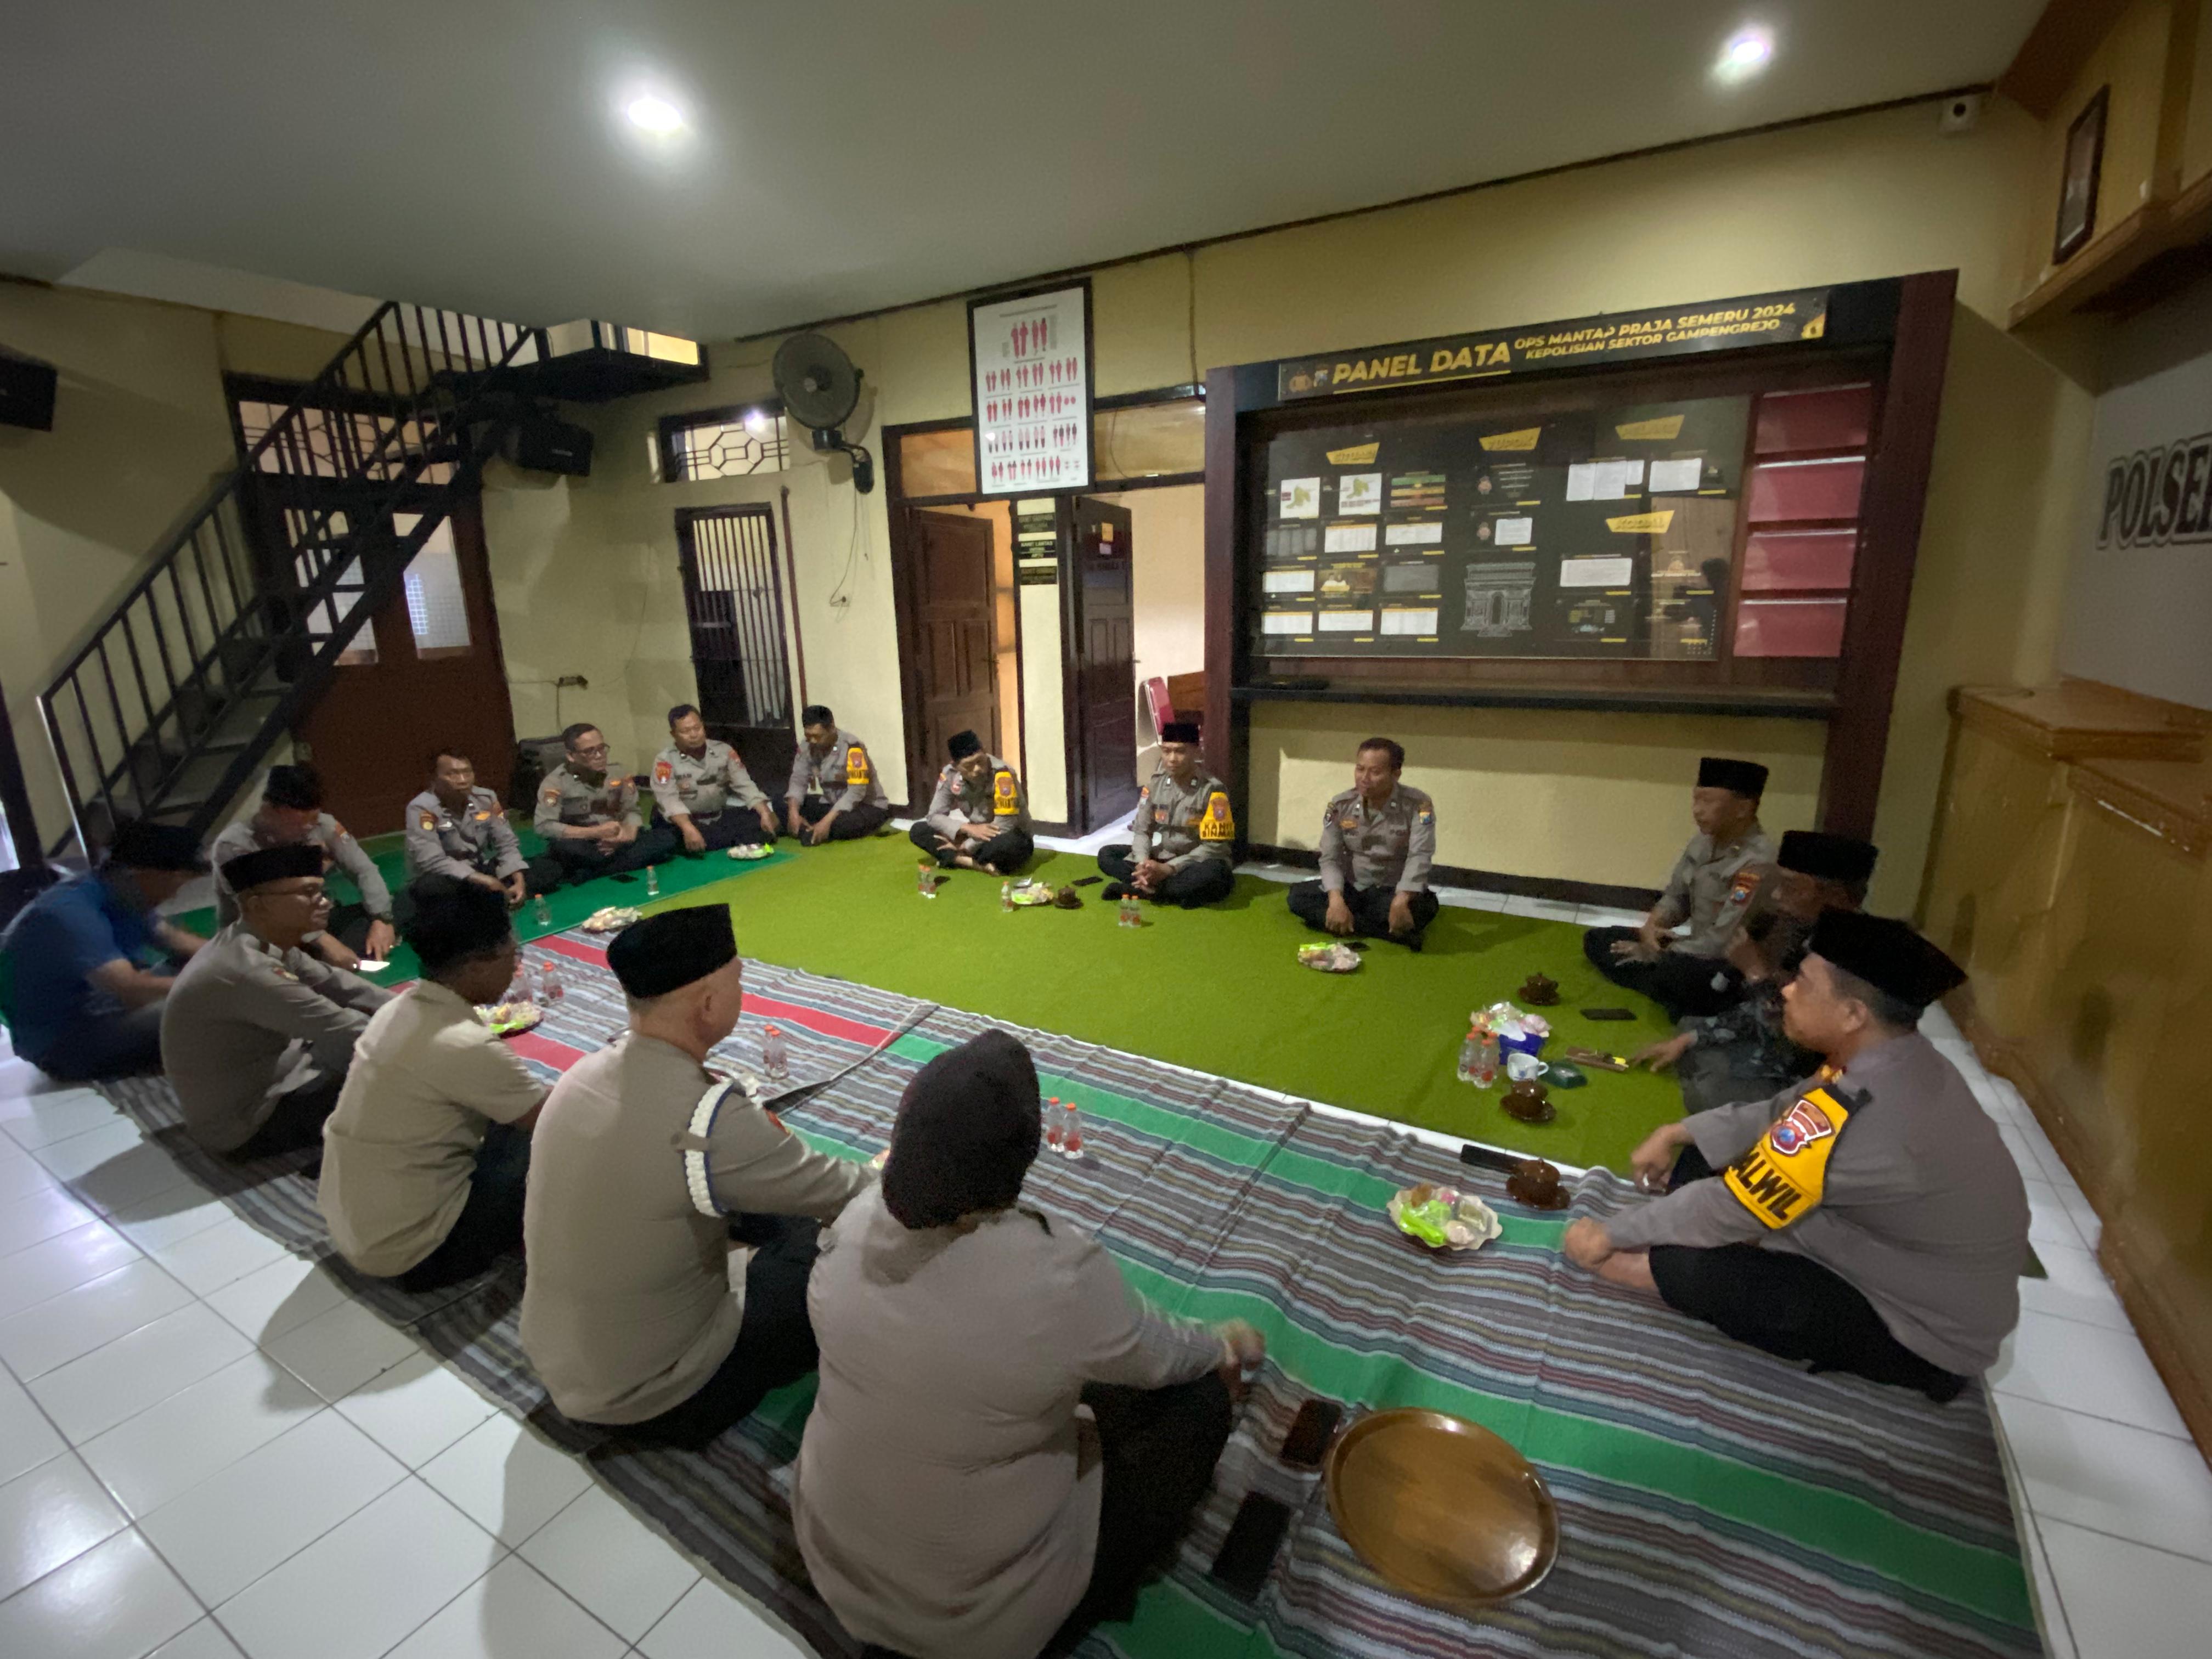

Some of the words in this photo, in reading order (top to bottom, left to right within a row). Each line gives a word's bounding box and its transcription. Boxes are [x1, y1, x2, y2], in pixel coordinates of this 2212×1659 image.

[1514, 336, 1544, 349] OPS
[1548, 326, 1616, 345] MANTAP
[1618, 318, 1672, 335] PRAJA
[1677, 308, 1750, 329] SEMERU
[1751, 302, 1796, 319] 2024
[1525, 340, 1605, 359] KEPOLISIAN
[1607, 332, 1662, 349] SEKTOR
[1666, 319, 1780, 342] GAMPENGREJO
[1332, 354, 1421, 385] PANEL
[1430, 342, 1511, 373] DATA
